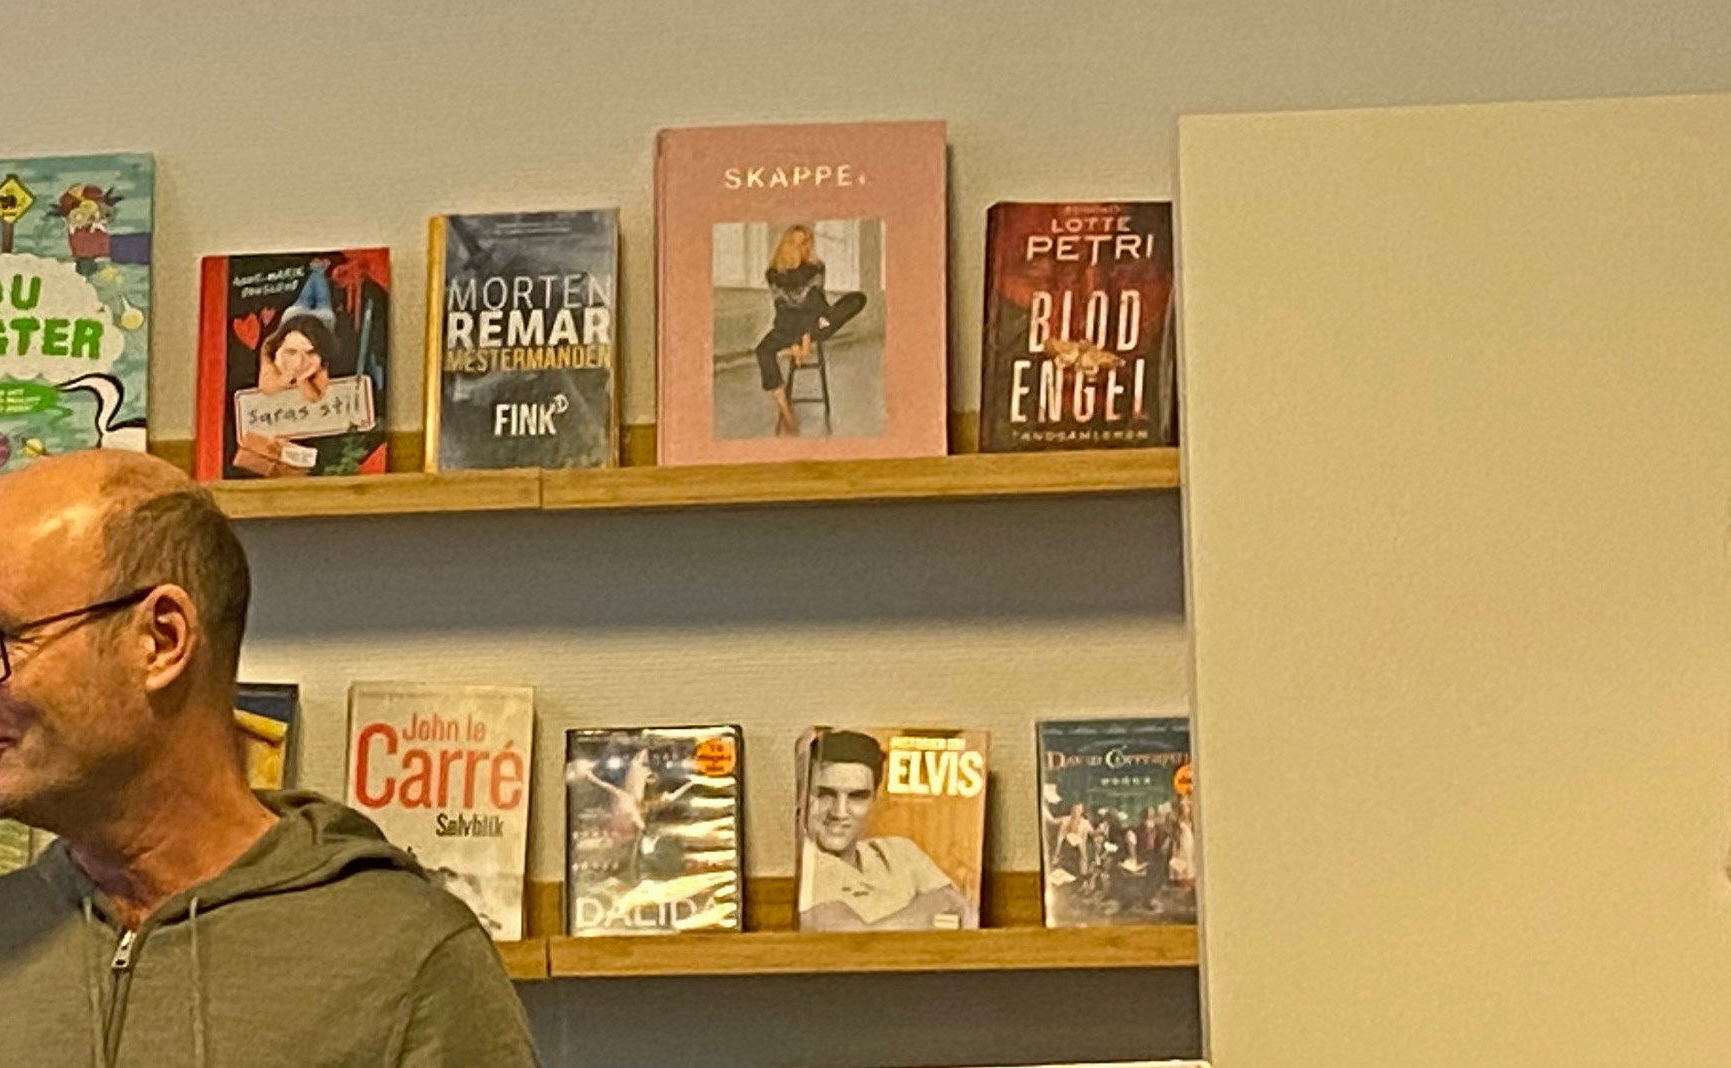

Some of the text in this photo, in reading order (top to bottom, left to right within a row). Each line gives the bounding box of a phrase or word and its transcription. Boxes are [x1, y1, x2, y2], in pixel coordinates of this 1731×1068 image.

[1051, 216, 1131, 233] LOTTE
[1026, 234, 1154, 266] PETRI
[447, 274, 612, 311] MORTEN
[447, 307, 612, 349] REMAR
[494, 403, 557, 436] FINK
[402, 713, 487, 742] John le
[356, 723, 523, 811] Carré
[887, 751, 983, 798] ELVIS
